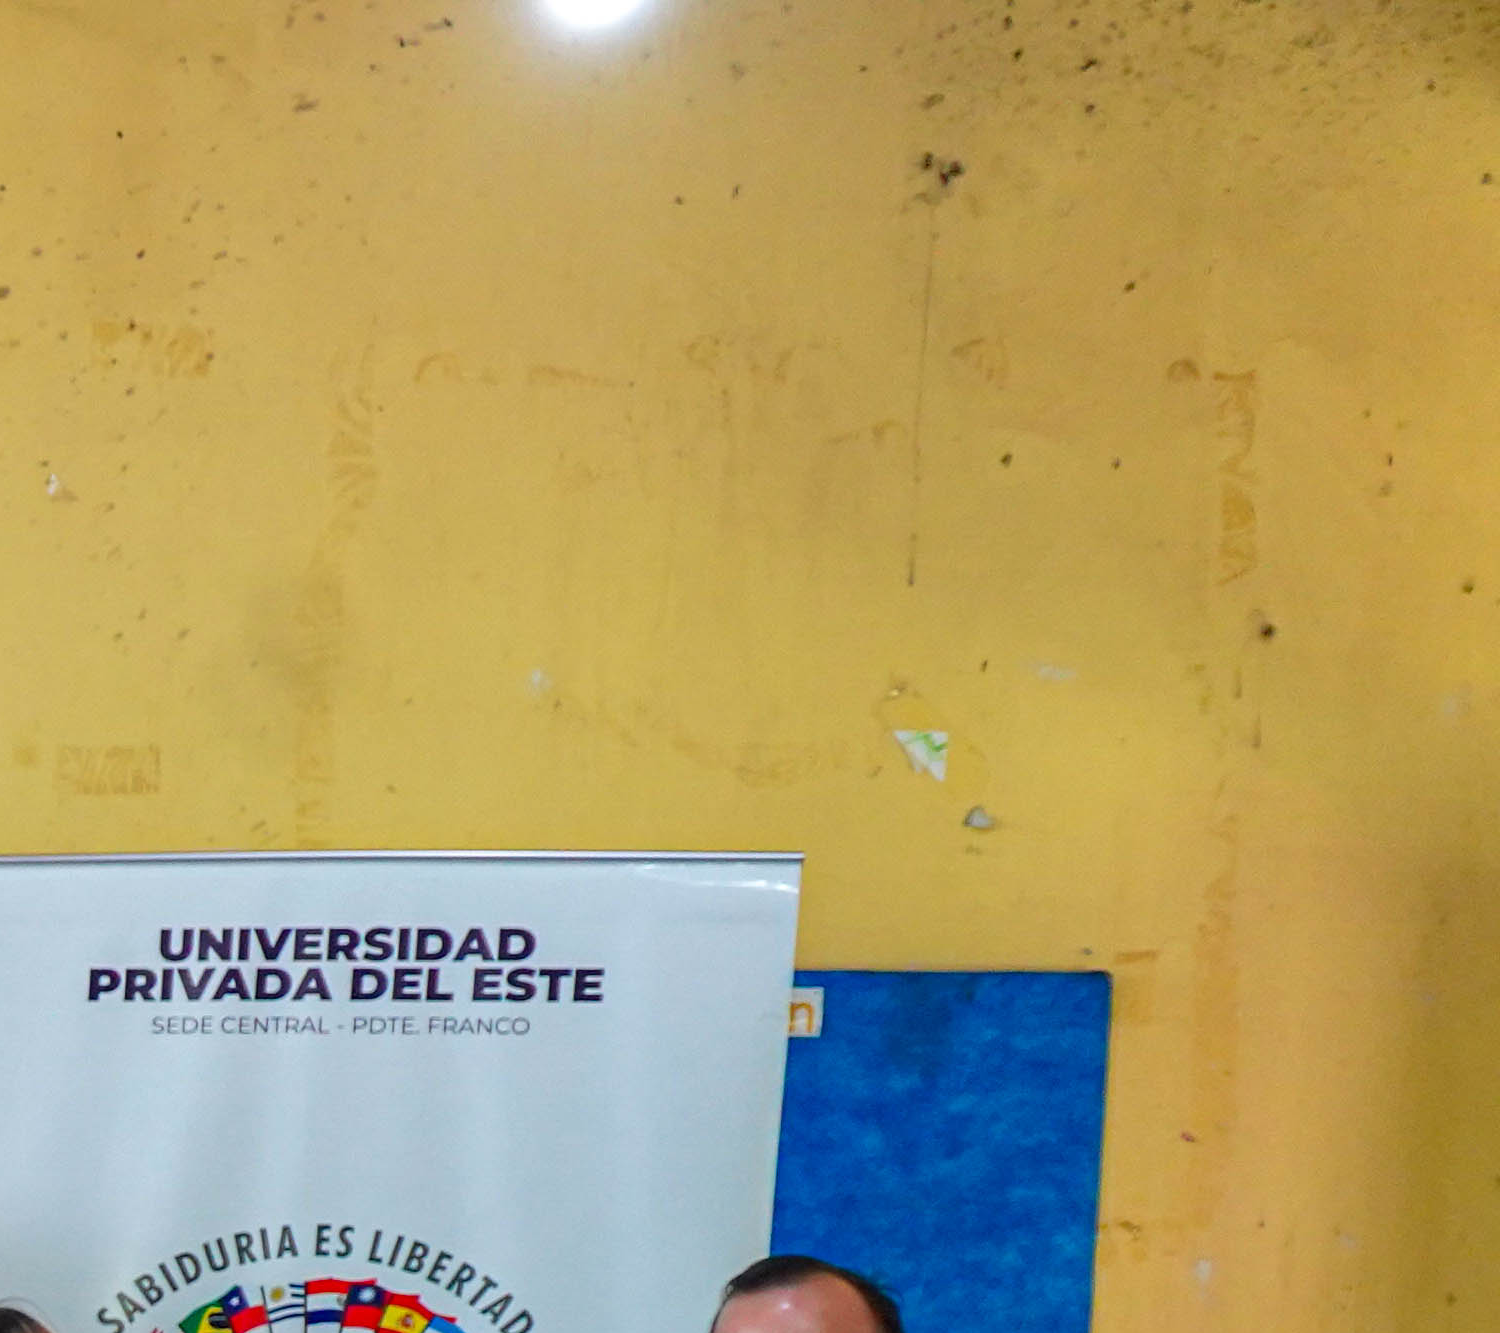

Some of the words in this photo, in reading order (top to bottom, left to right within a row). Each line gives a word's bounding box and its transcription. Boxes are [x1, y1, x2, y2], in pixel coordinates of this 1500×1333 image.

[159, 928, 536, 962] UNIVERSIDAD
[88, 968, 332, 1002] PRIVADA
[350, 968, 454, 1002] DEL
[472, 968, 605, 1003] ESTE
[151, 1016, 213, 1035] SEDE
[220, 1016, 331, 1035] CENTRAL
[352, 1016, 421, 1036] PDTE.
[428, 1016, 532, 1037] FRANCO
[314, 1223, 356, 1258] ES
